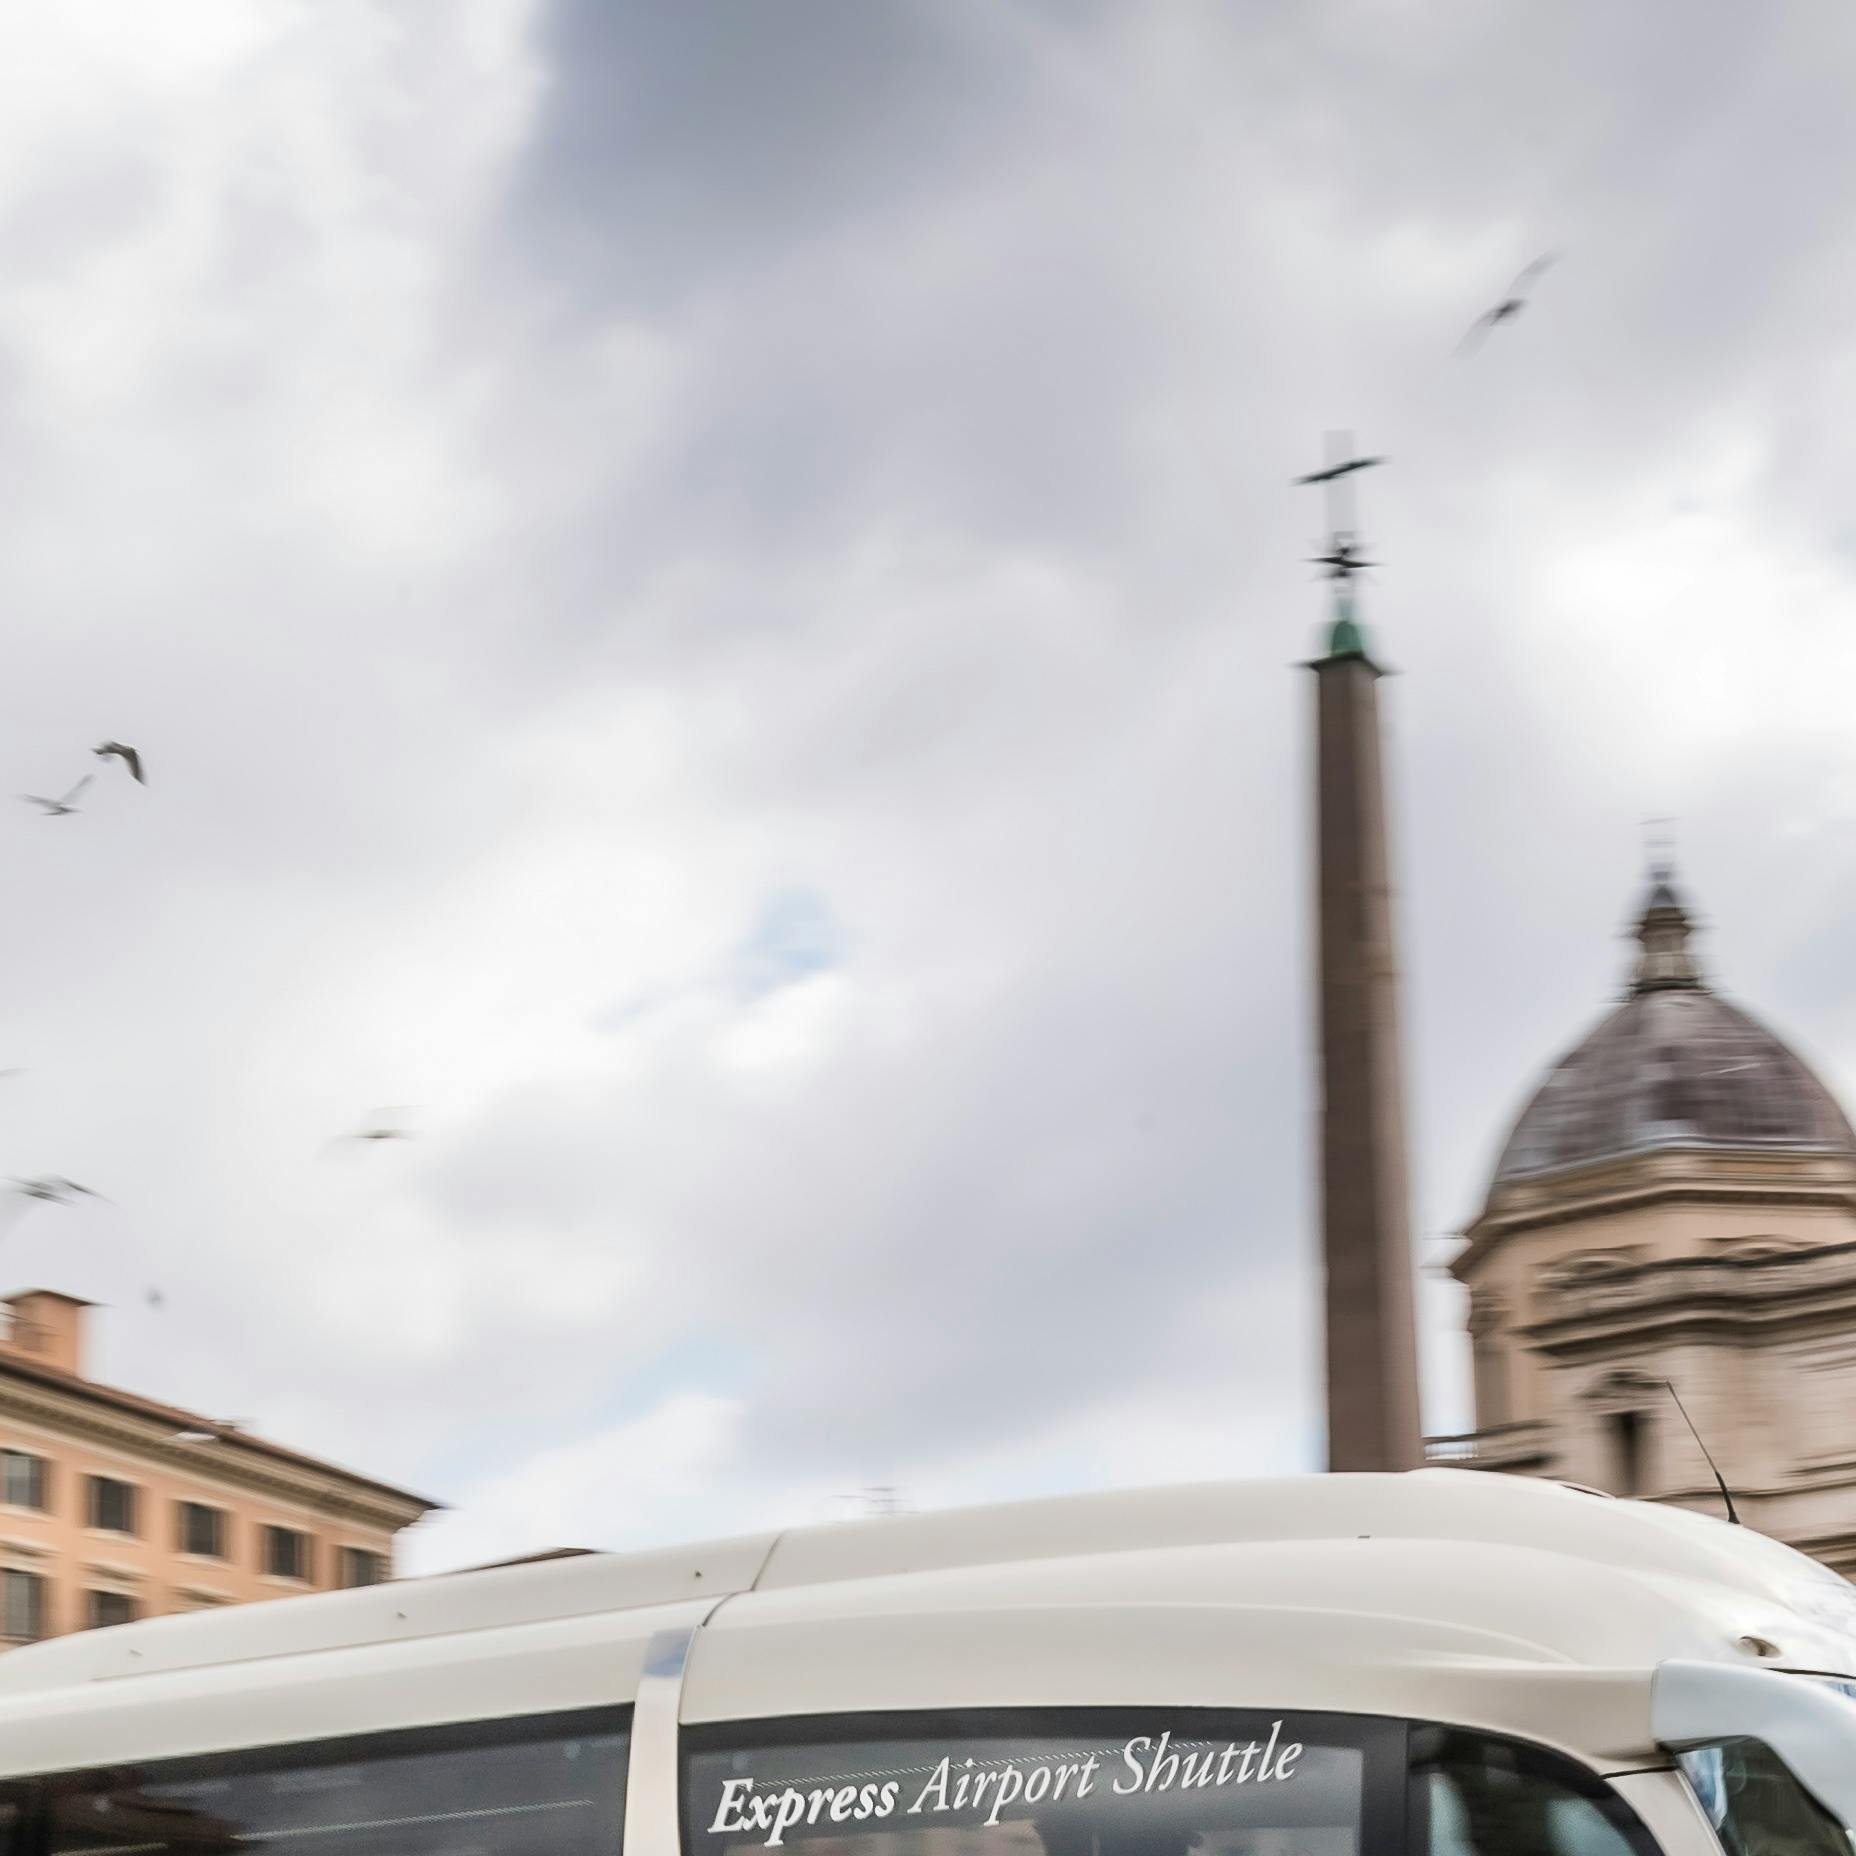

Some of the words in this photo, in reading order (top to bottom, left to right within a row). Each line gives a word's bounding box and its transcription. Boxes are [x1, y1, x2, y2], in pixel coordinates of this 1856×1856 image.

[707, 1777, 900, 1847] Express
[907, 1757, 1100, 1827] Airport
[1112, 1720, 1305, 1795] Shuttle
